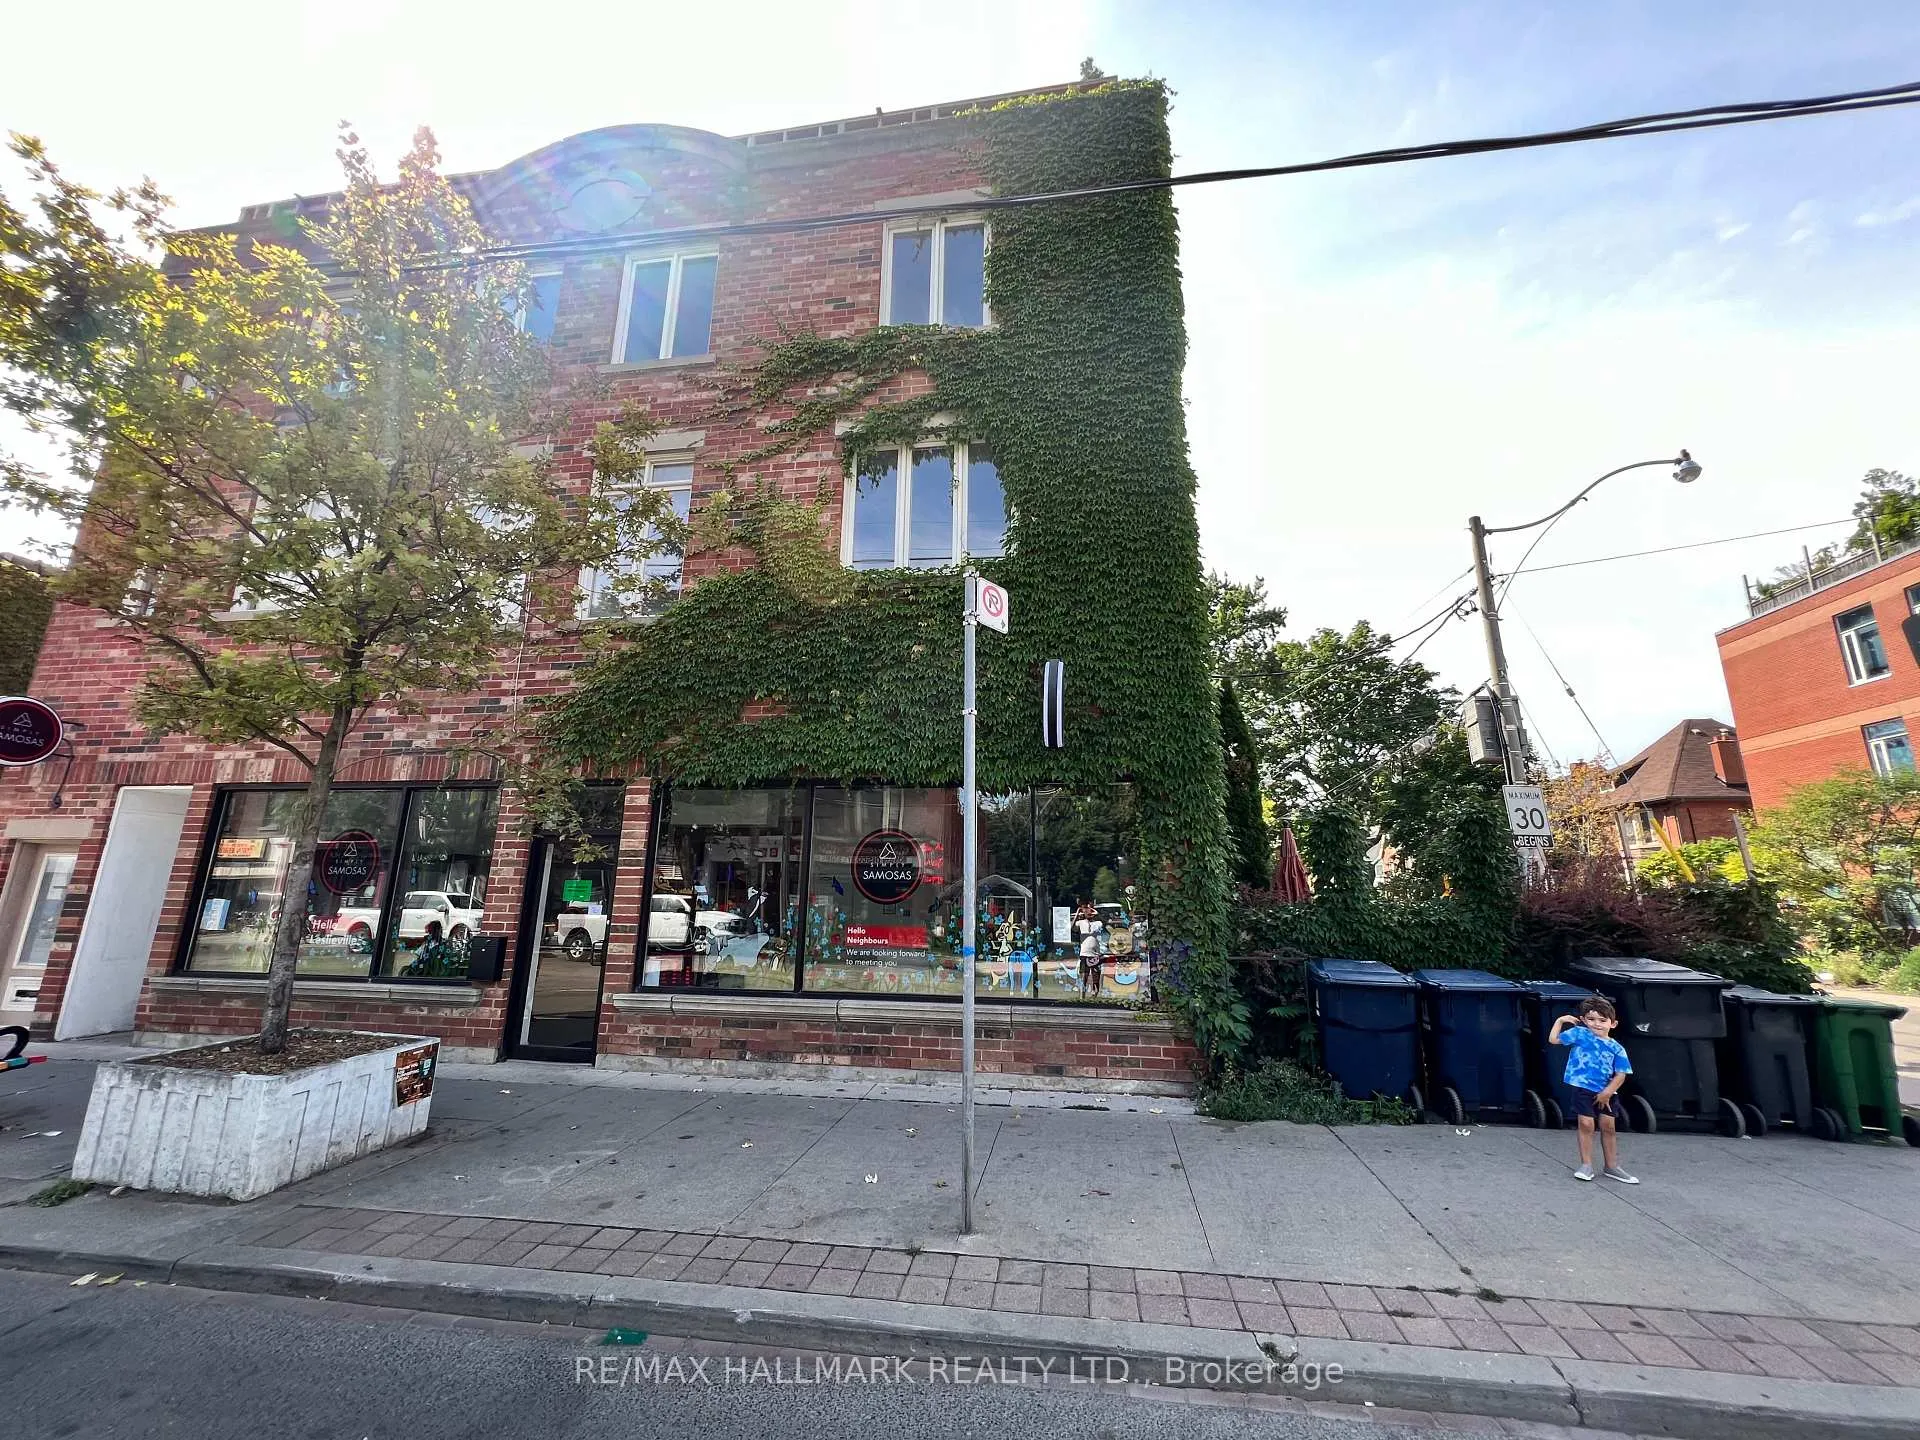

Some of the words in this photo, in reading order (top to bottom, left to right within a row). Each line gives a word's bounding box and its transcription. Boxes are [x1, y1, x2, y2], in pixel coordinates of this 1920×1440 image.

[0, 732, 45, 747] AMOSAS
[1508, 791, 1541, 800] MAXIMUM
[1514, 807, 1545, 830] 30
[1517, 836, 1550, 847] BEGINS
[328, 866, 368, 875] SAMOSAS
[862, 870, 912, 880] SAMOSAS
[311, 919, 338, 931] Hello
[847, 926, 866, 934] Hello
[846, 936, 889, 946] Neighbours
[846, 948, 858, 956] We
[872, 949, 898, 958] looking
[899, 949, 926, 957] forward
[854, 959, 883, 968] meeting
